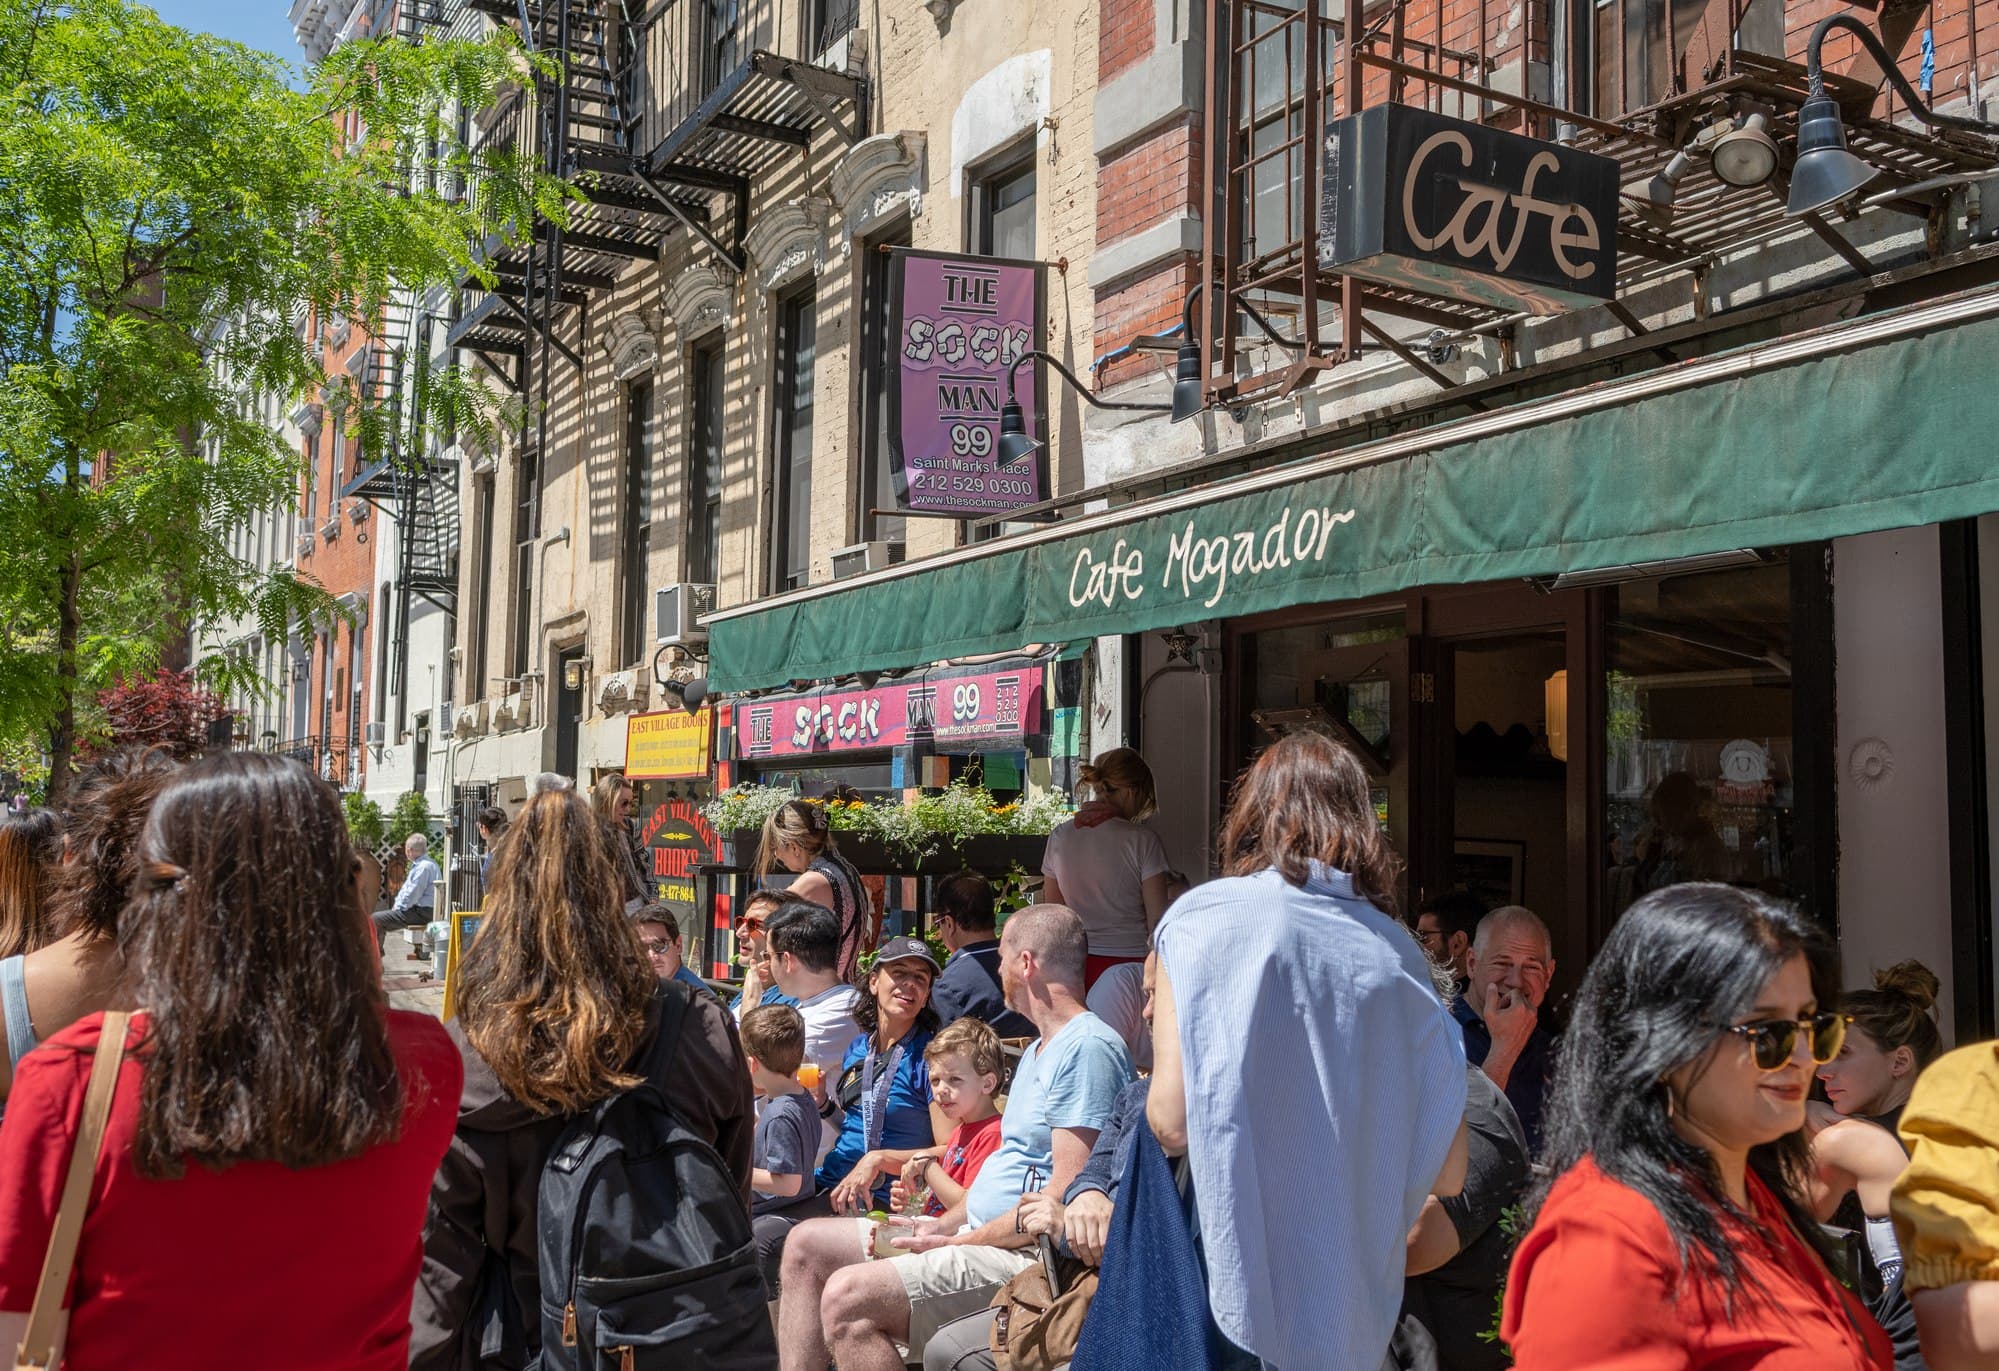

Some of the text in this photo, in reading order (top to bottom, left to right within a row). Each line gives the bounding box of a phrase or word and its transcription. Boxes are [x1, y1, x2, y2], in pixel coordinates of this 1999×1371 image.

[1402, 130, 1600, 279] Cafe
[942, 274, 998, 306] THE
[905, 319, 1029, 366] SOCK
[938, 384, 999, 414] MAN
[950, 423, 992, 457] 99
[913, 457, 949, 470] Saint
[952, 458, 990, 473] Marks
[915, 474, 1032, 495] 212 529 0300
[1069, 507, 1356, 608] Cafe Mogador
[631, 713, 708, 734] EAST VILLAGE BOOKS
[751, 683, 981, 747] THE SOCK MAN 99
[936, 723, 994, 736] www.thesockman.com
[642, 802, 667, 848] EAST
